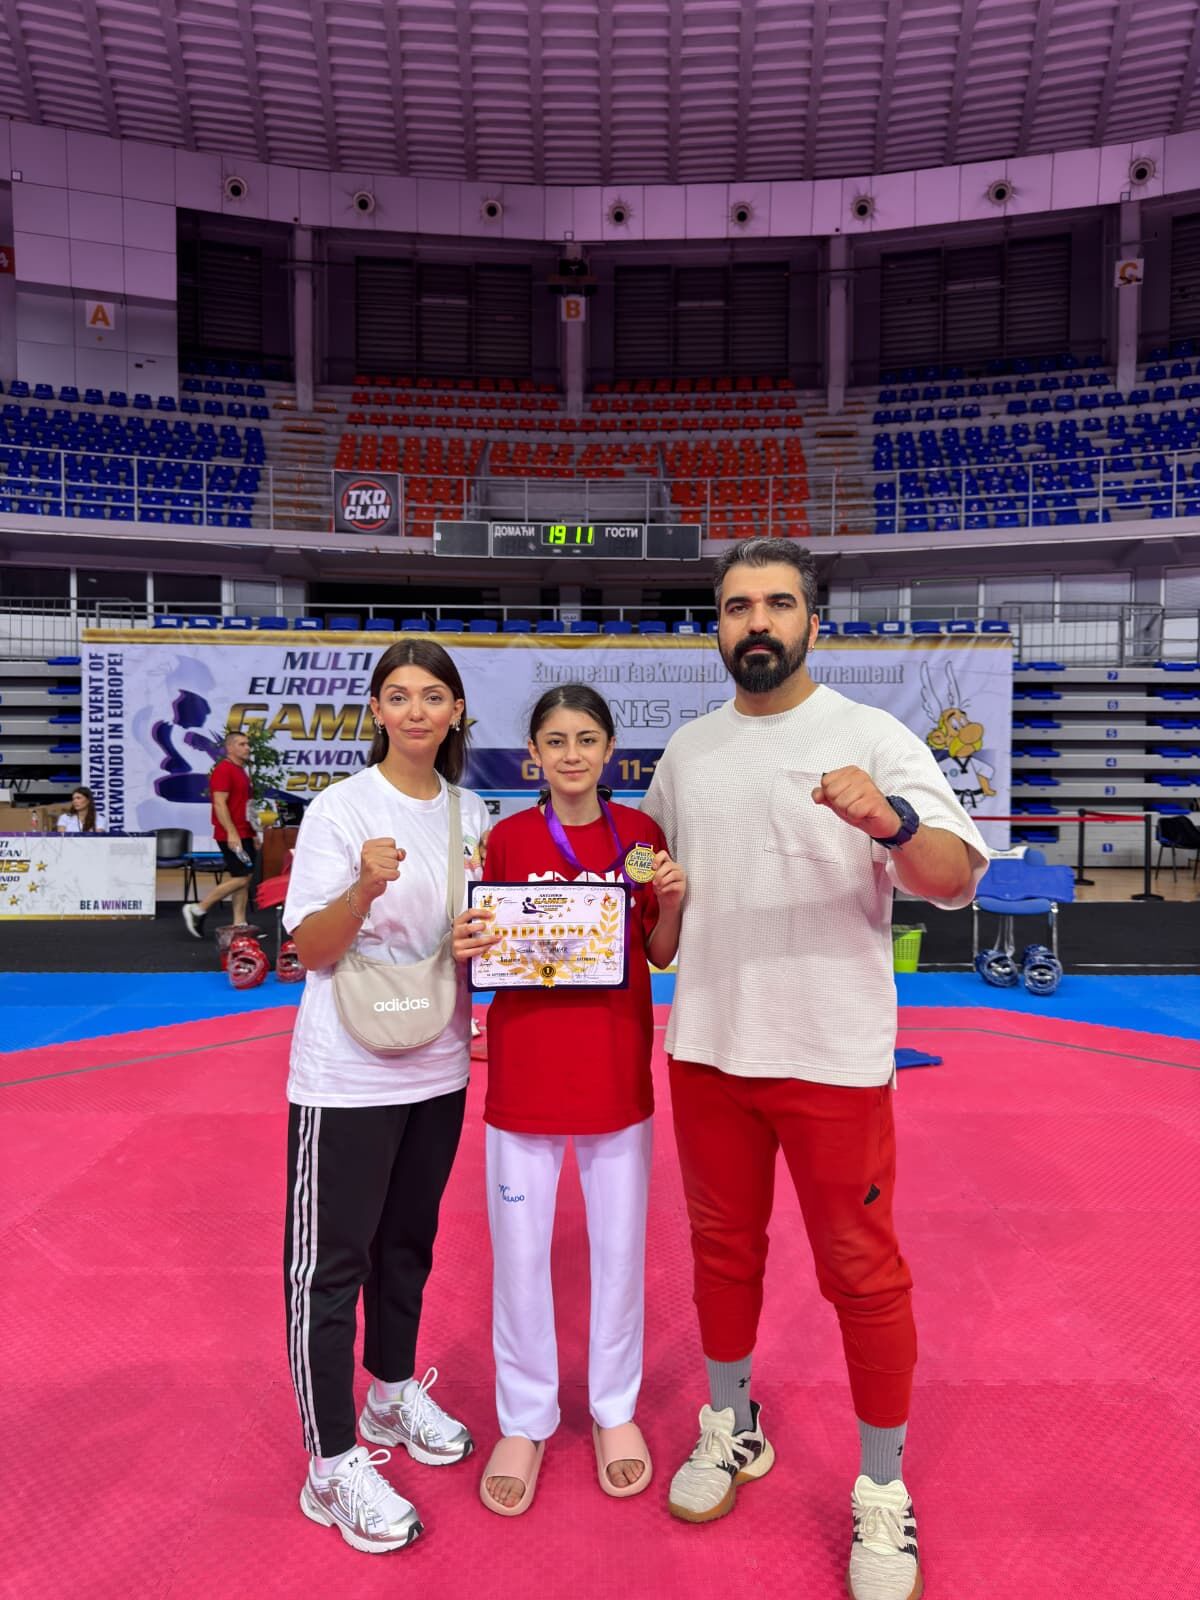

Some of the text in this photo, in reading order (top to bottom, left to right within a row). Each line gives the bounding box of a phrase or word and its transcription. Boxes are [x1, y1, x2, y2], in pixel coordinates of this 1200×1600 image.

[90, 304, 110, 327] A
[566, 299, 581, 319] B
[349, 490, 386, 505] TKD
[344, 505, 390, 520] CLAN
[494, 526, 535, 538] ДОМАЋИ
[549, 526, 566, 544] 19
[605, 527, 638, 538] ГОСТИ
[283, 651, 372, 671] MULTI
[533, 663, 620, 683] European
[808, 665, 904, 683] urnament
[248, 677, 371, 696] EUROPE
[609, 700, 671, 728] NIS
[88, 653, 106, 817] OGNIZABLE EVENT OF
[108, 653, 125, 832] AEKWONDO IN EUROPE!
[275, 750, 366, 766] EKWON
[618, 759, 658, 780] 11-
[80, 900, 142, 910] BE A WINNER!
[493, 925, 601, 938] DIPLOMA
[373, 997, 430, 1012] adidas
